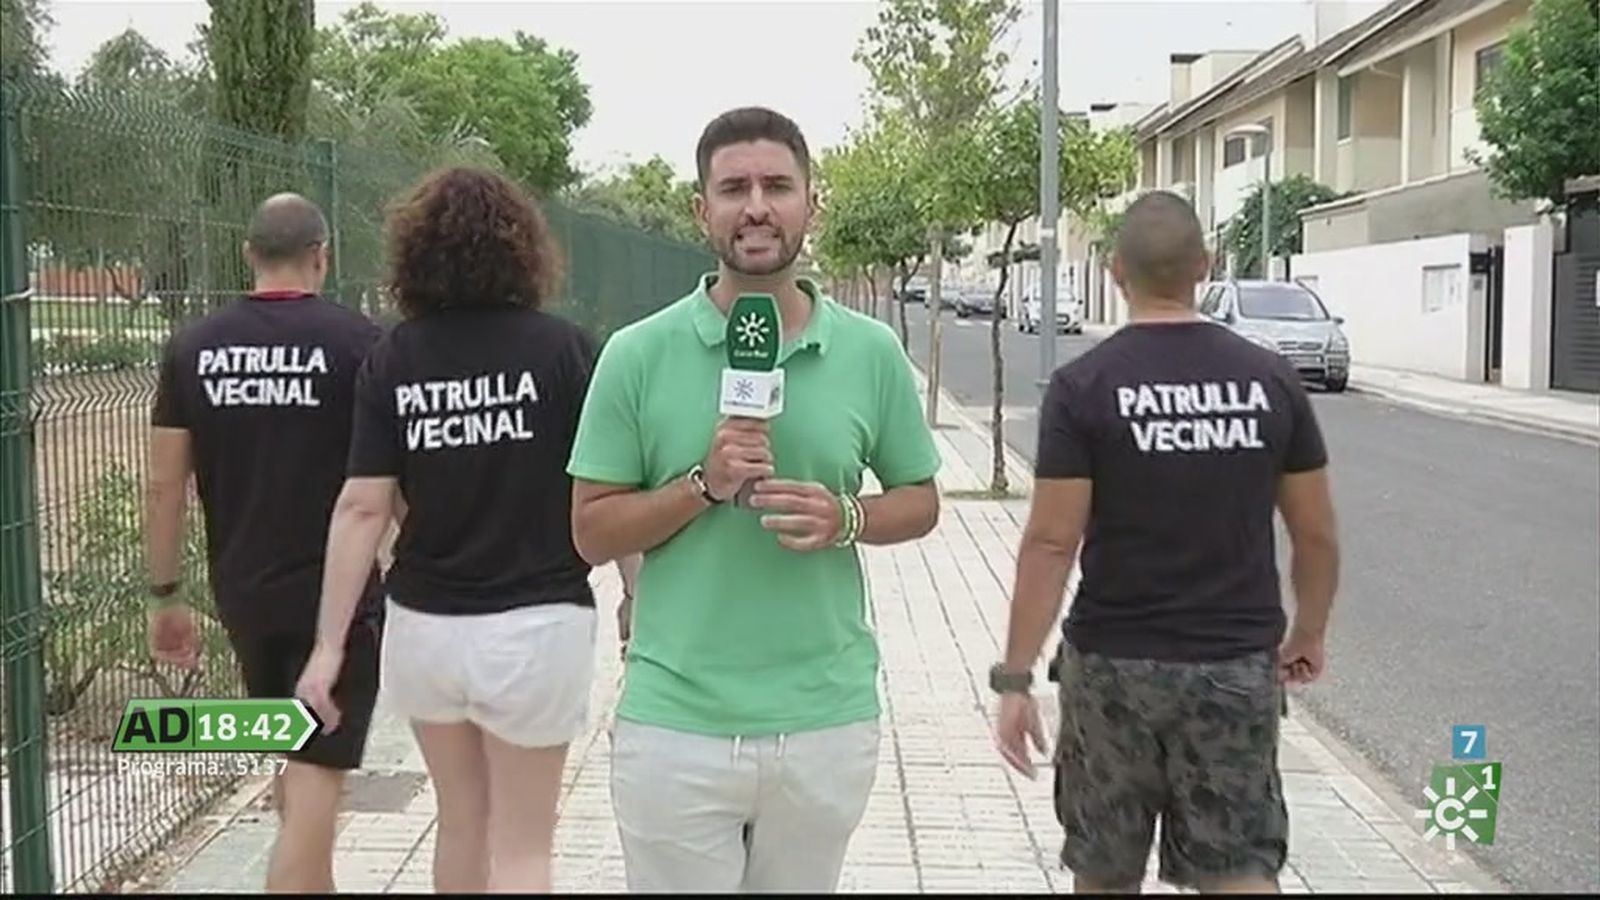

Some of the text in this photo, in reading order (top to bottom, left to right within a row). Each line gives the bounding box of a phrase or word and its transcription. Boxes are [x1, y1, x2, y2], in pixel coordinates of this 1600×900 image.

[198, 345, 328, 376] PATRULLA
[204, 377, 320, 407] VECINAL
[396, 371, 538, 417] PATRULLA
[1117, 381, 1270, 416] PATRULLA
[406, 409, 534, 452] VECINAL
[1131, 418, 1265, 452] VECINAL
